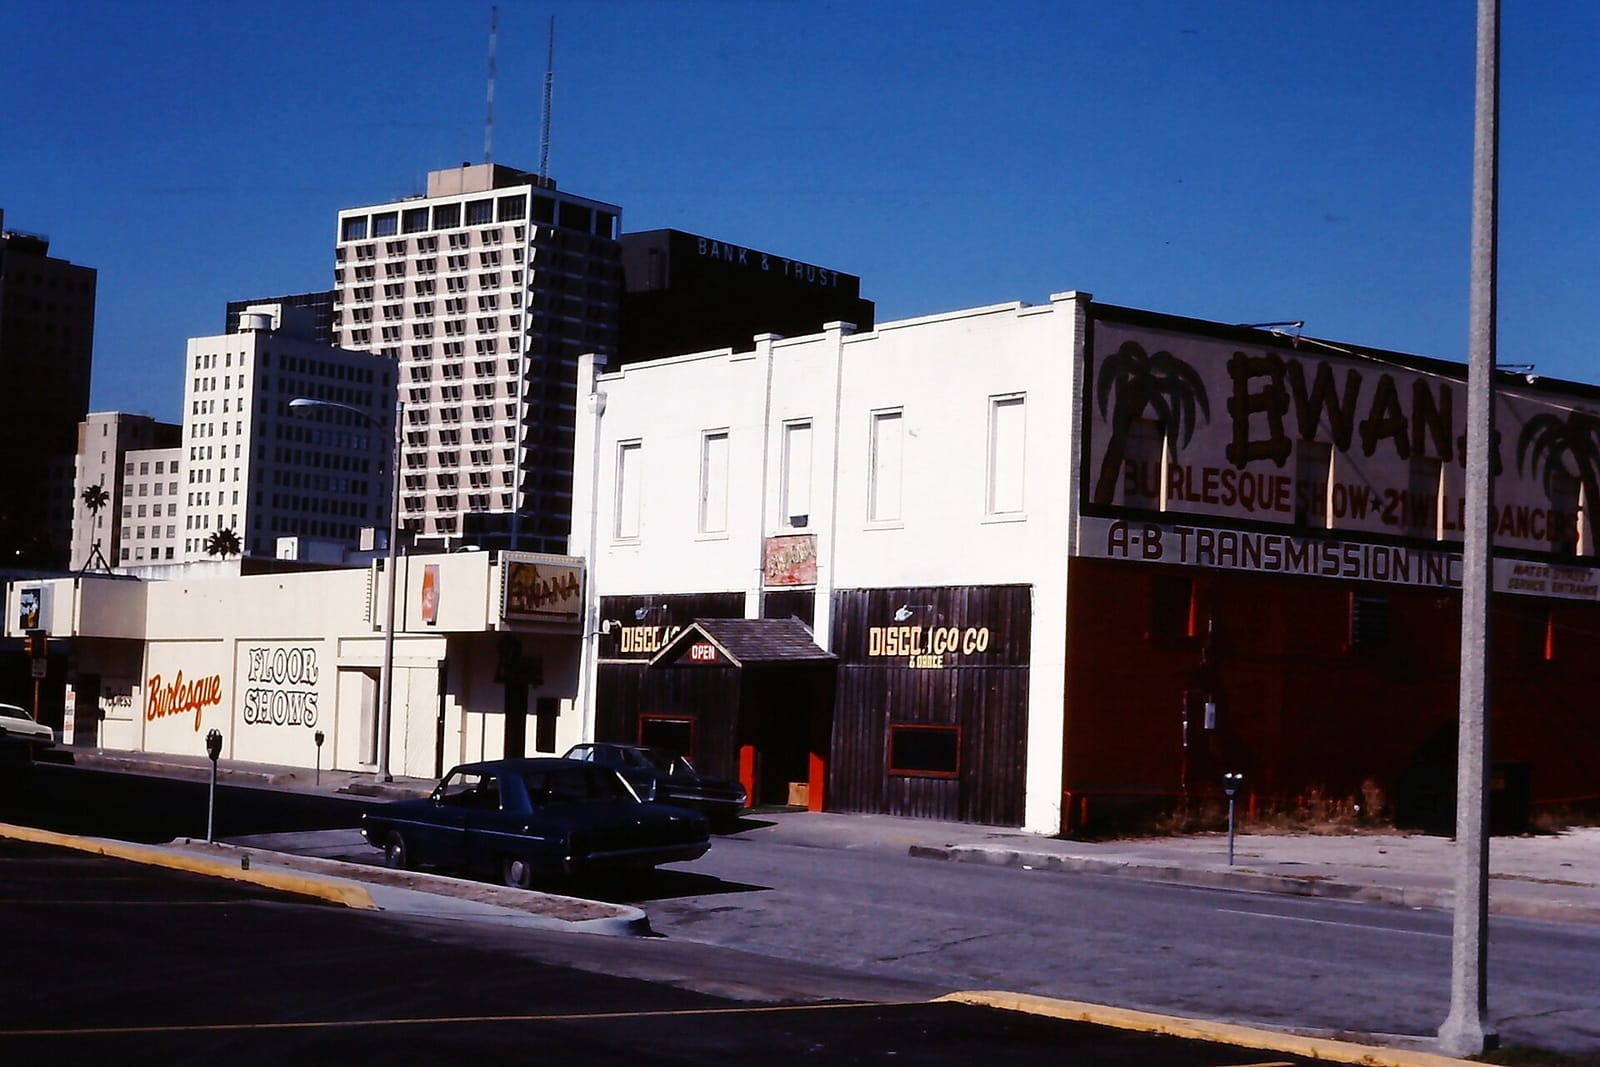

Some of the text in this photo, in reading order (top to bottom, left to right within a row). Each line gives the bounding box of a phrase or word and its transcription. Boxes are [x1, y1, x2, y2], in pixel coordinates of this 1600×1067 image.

[696, 238, 840, 289] BANK & TRUST
[1226, 350, 1503, 476] BWAN
[1124, 460, 1291, 512] BURLESQUE
[1296, 479, 1370, 521] SHOW
[1382, 487, 1409, 527] 21
[1107, 520, 1162, 559] A-B
[1174, 527, 1414, 582] TRANSMISSION
[691, 645, 715, 660] OPEN
[934, 627, 960, 656] GO
[962, 627, 989, 656] GO
[248, 648, 319, 687] FLOOR
[147, 669, 222, 732] Burlesque
[243, 688, 319, 728] SHOWS
